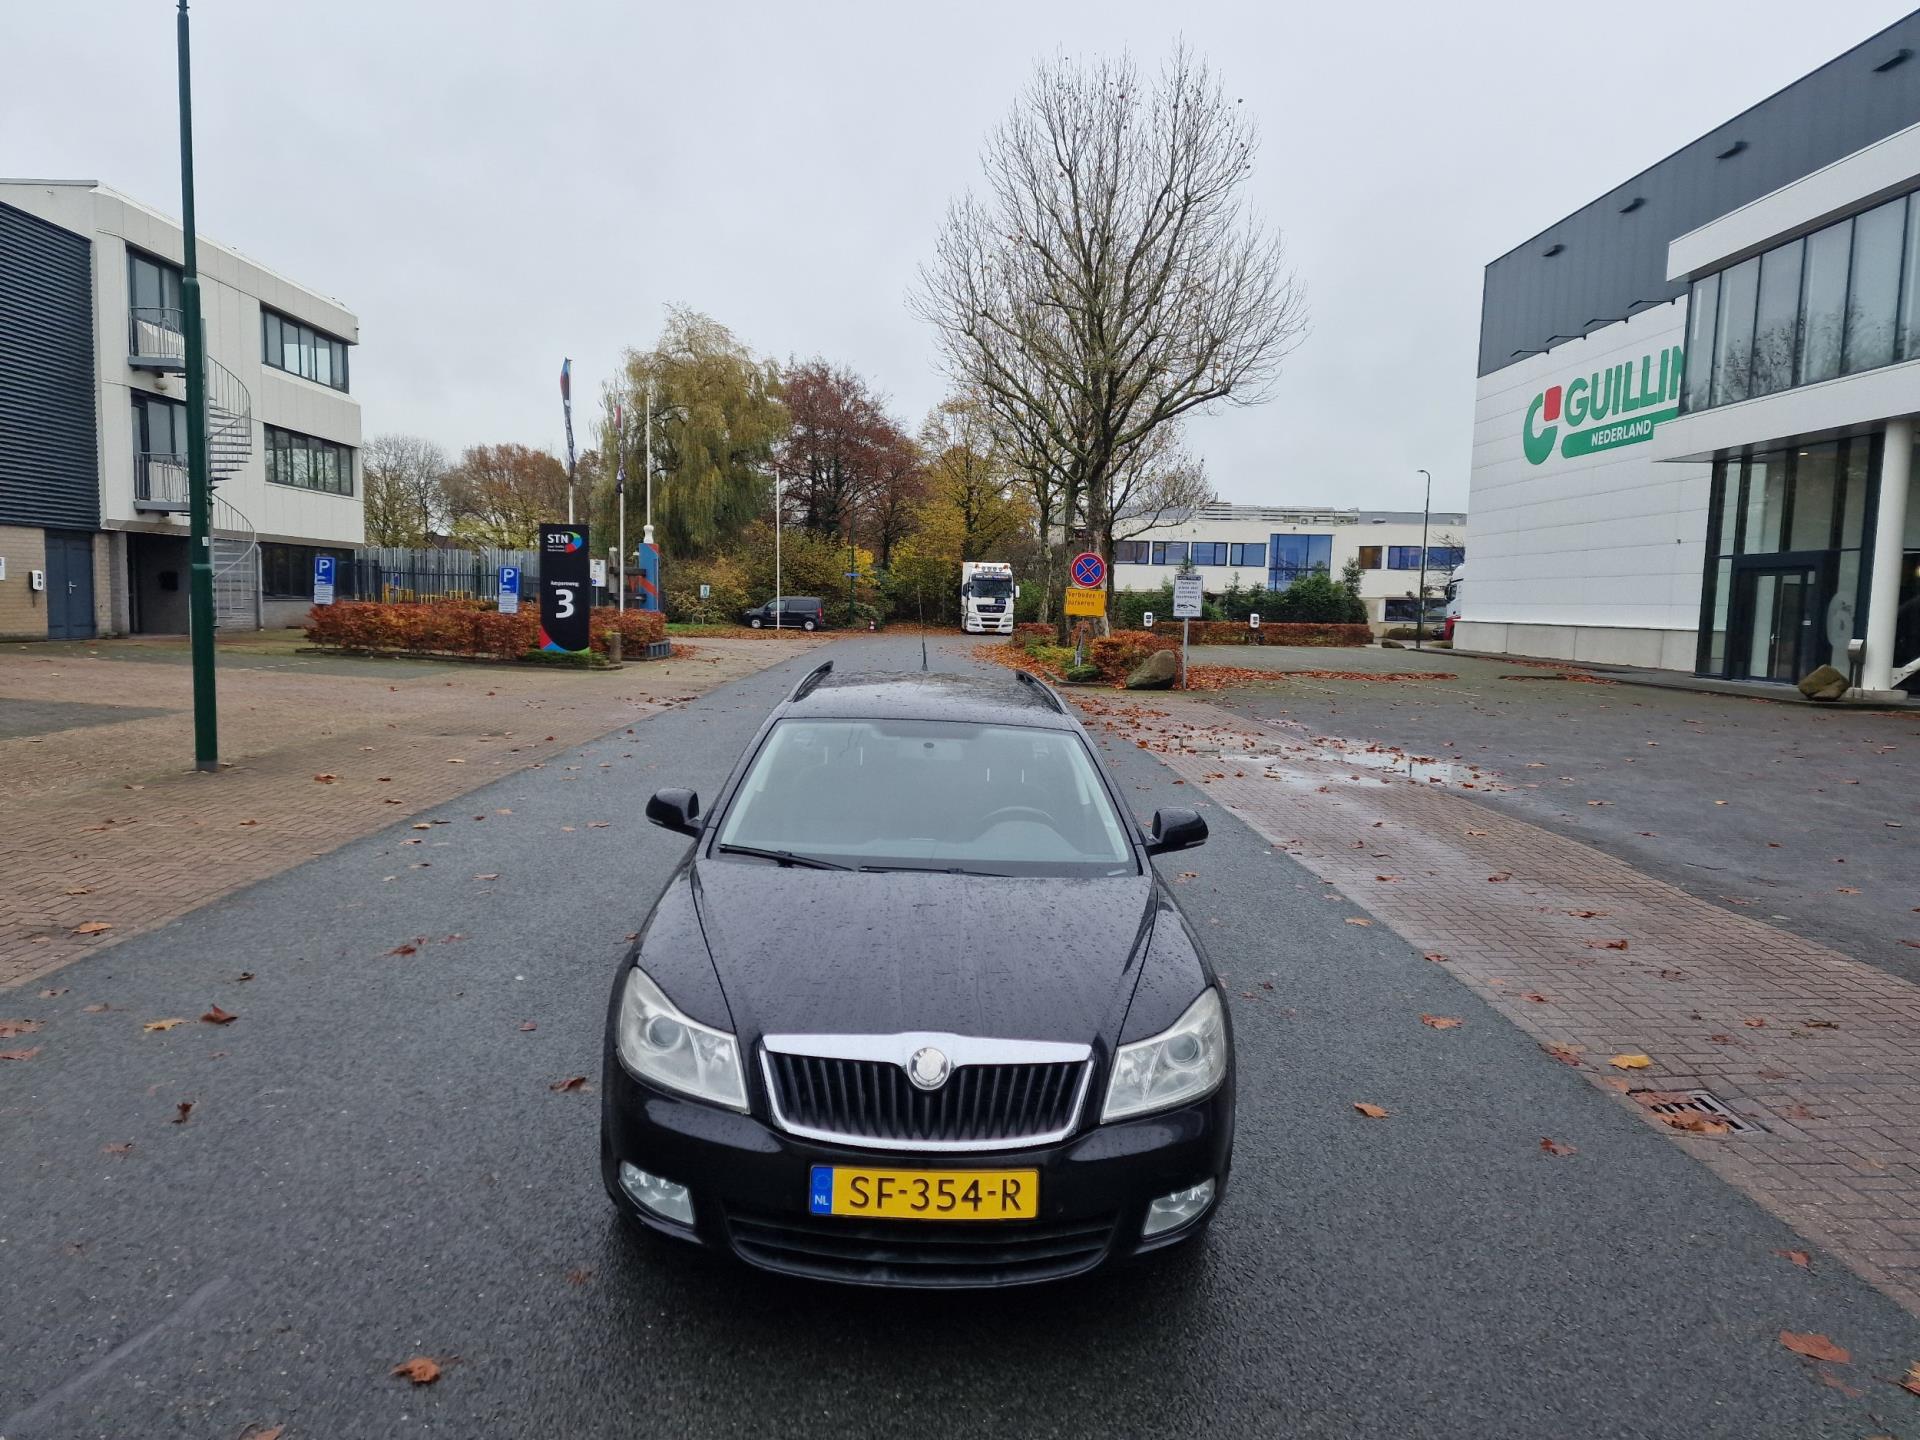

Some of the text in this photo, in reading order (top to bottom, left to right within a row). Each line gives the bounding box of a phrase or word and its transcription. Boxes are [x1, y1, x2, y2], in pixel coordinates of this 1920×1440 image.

[1591, 419, 1651, 446] NEDERLAND
[547, 534, 569, 544] STN
[319, 559, 330, 573] P
[503, 568, 514, 582] P
[555, 588, 575, 619] 3
[814, 1195, 829, 1206] NL
[849, 1176, 1022, 1212] SF-354-R
